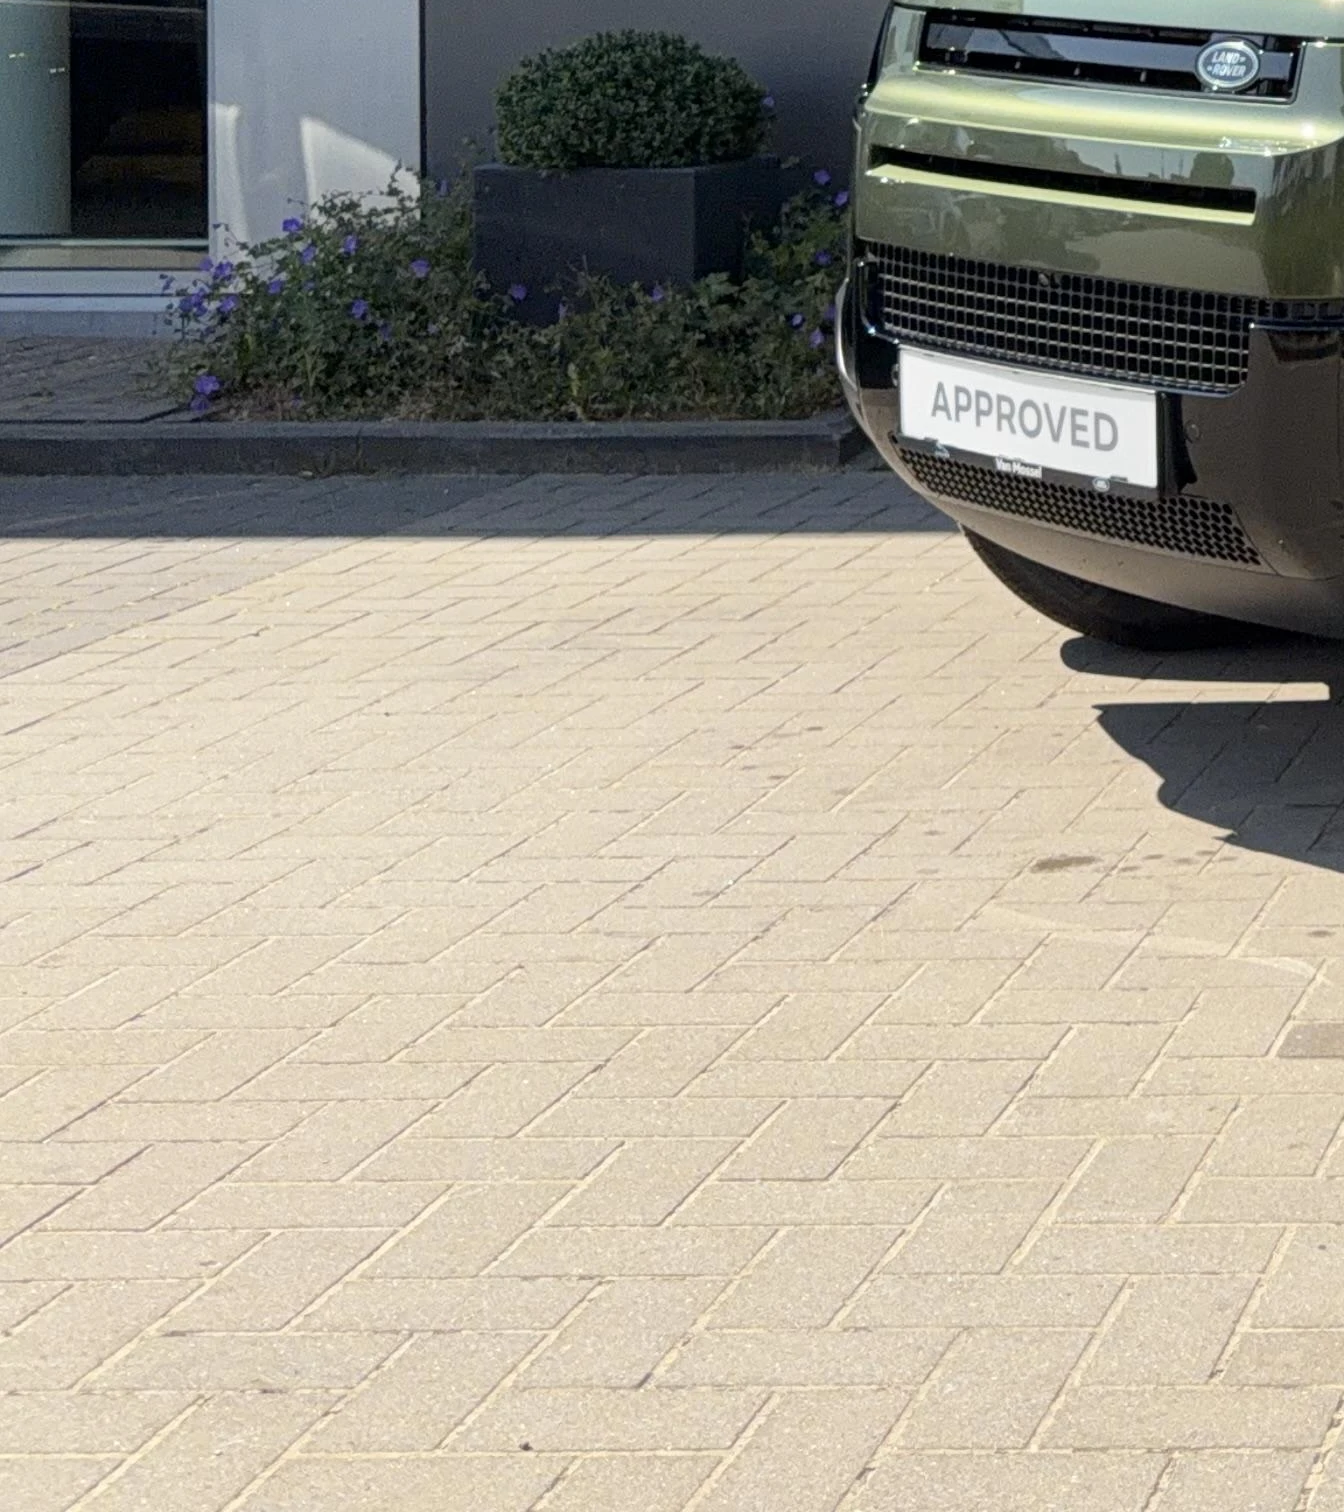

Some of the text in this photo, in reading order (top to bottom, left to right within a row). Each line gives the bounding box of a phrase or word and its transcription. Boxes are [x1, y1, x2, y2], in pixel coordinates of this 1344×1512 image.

[1211, 51, 1240, 65] LAND
[1211, 63, 1247, 77] ROVER
[931, 381, 1119, 452] APPROVED
